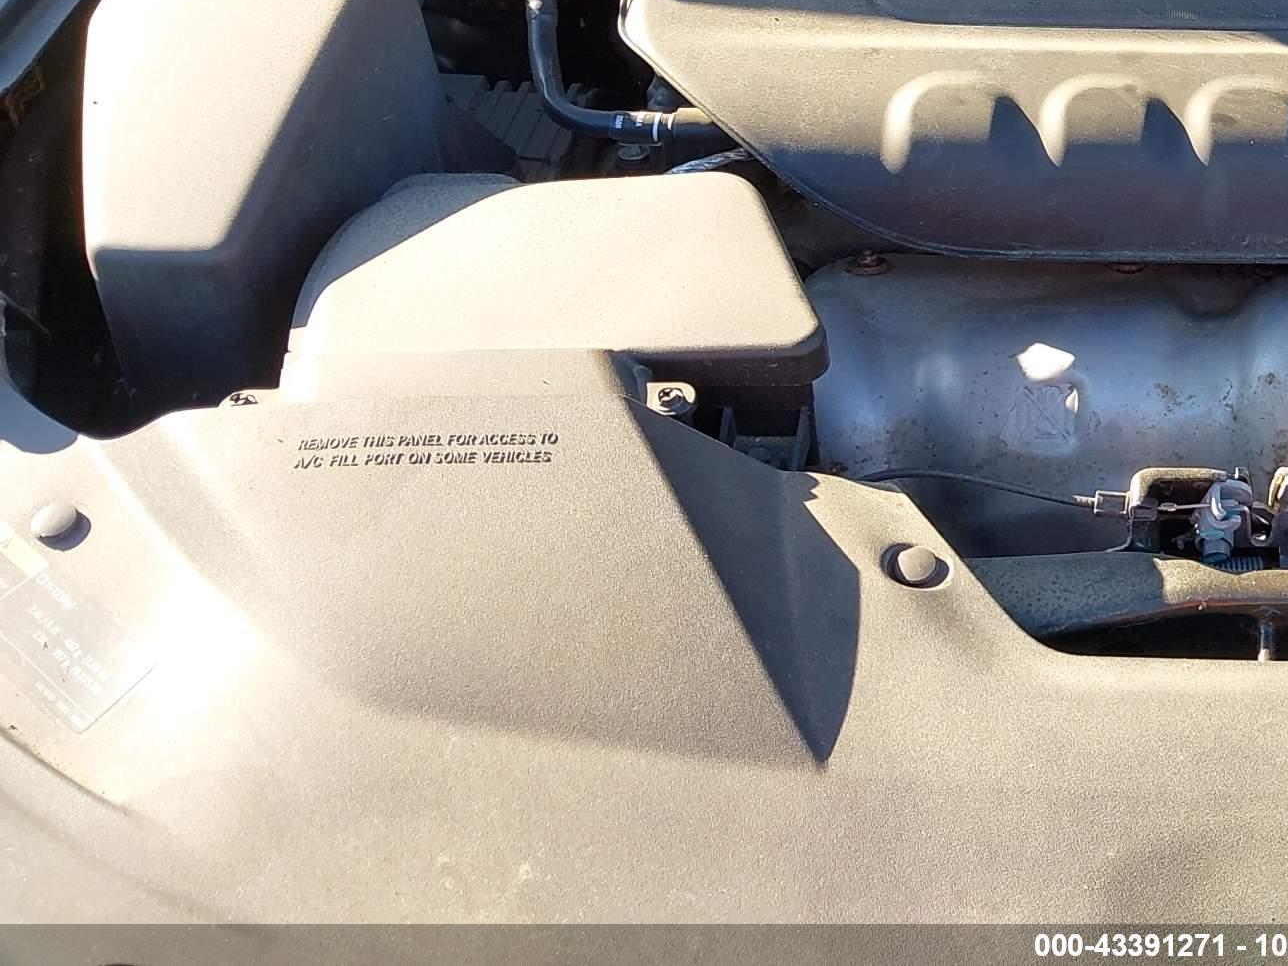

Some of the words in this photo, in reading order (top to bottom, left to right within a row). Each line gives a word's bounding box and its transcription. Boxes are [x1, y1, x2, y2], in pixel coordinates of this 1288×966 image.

[298, 436, 358, 451] REMOVE
[363, 435, 395, 448] THIS
[397, 434, 443, 447] PANEL
[446, 434, 477, 446] FOR
[479, 433, 537, 446] ACCESS
[539, 433, 560, 445] TO
[294, 454, 323, 469] A/C
[328, 453, 359, 467] FILL
[363, 453, 405, 466] PORT
[408, 452, 432, 465] ON
[434, 451, 477, 464] SOME
[481, 450, 553, 464] VEHICLES
